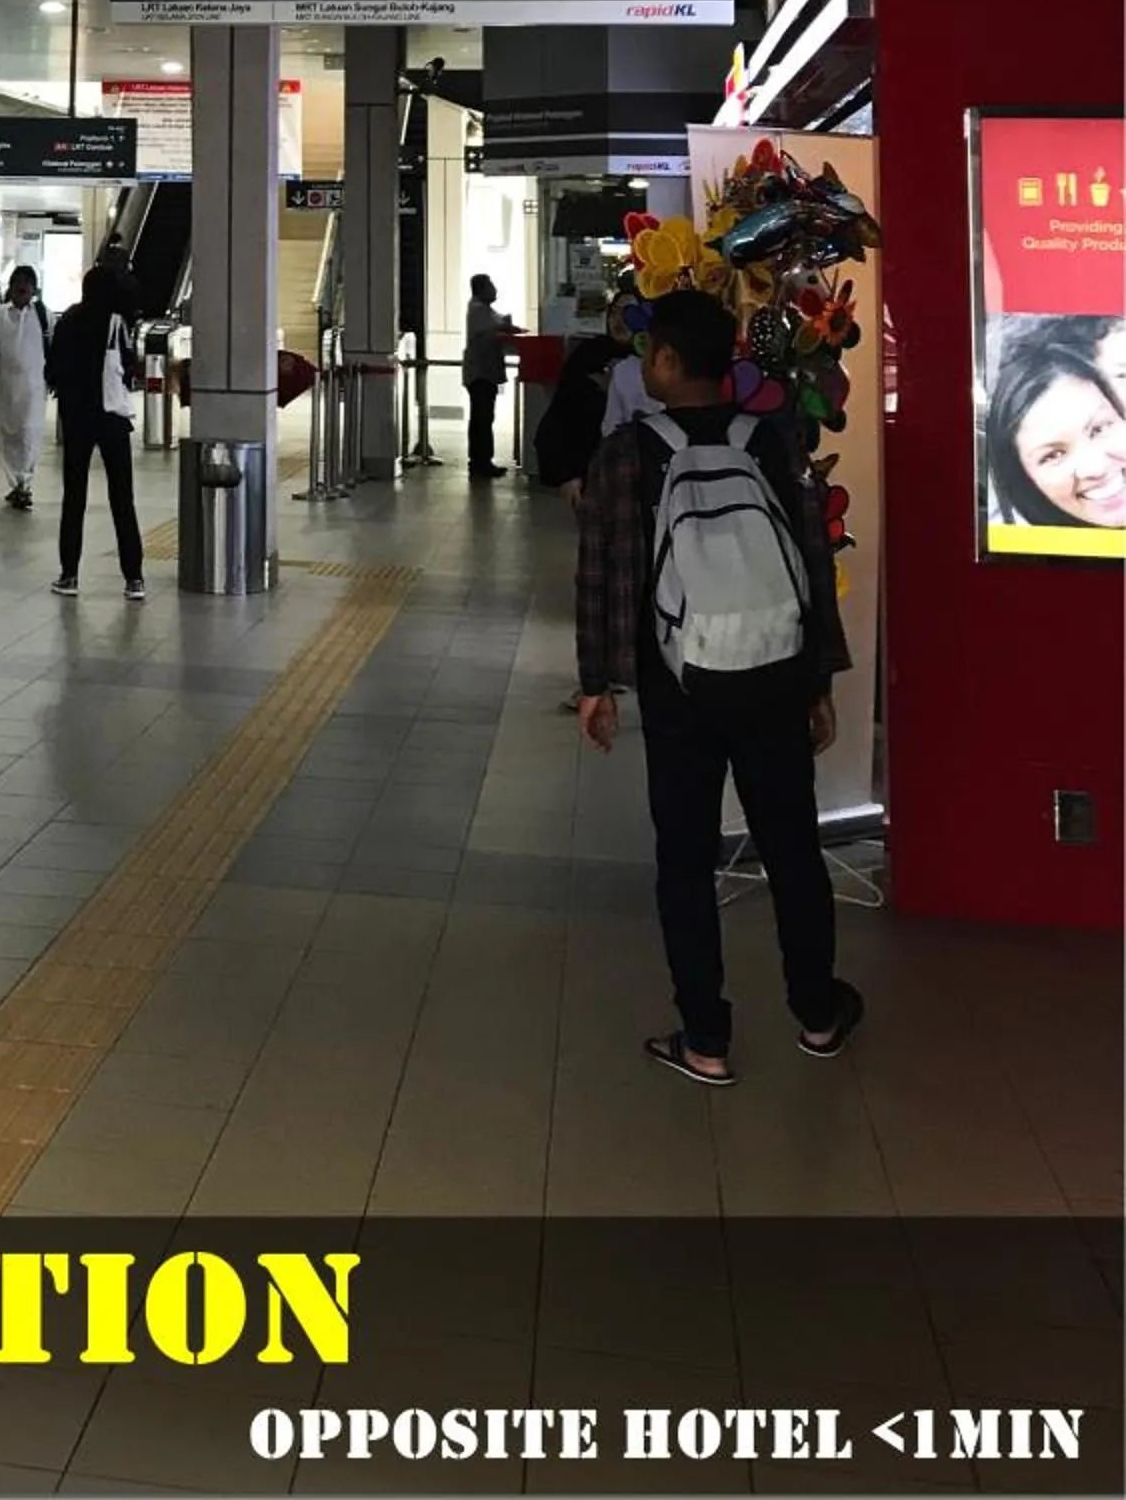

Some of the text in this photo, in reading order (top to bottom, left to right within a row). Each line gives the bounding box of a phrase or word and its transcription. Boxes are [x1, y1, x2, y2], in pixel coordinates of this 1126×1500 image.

[626, 3, 697, 18] rapidKL
[1049, 219, 1122, 235] Providing
[1022, 236, 1078, 252] Quality
